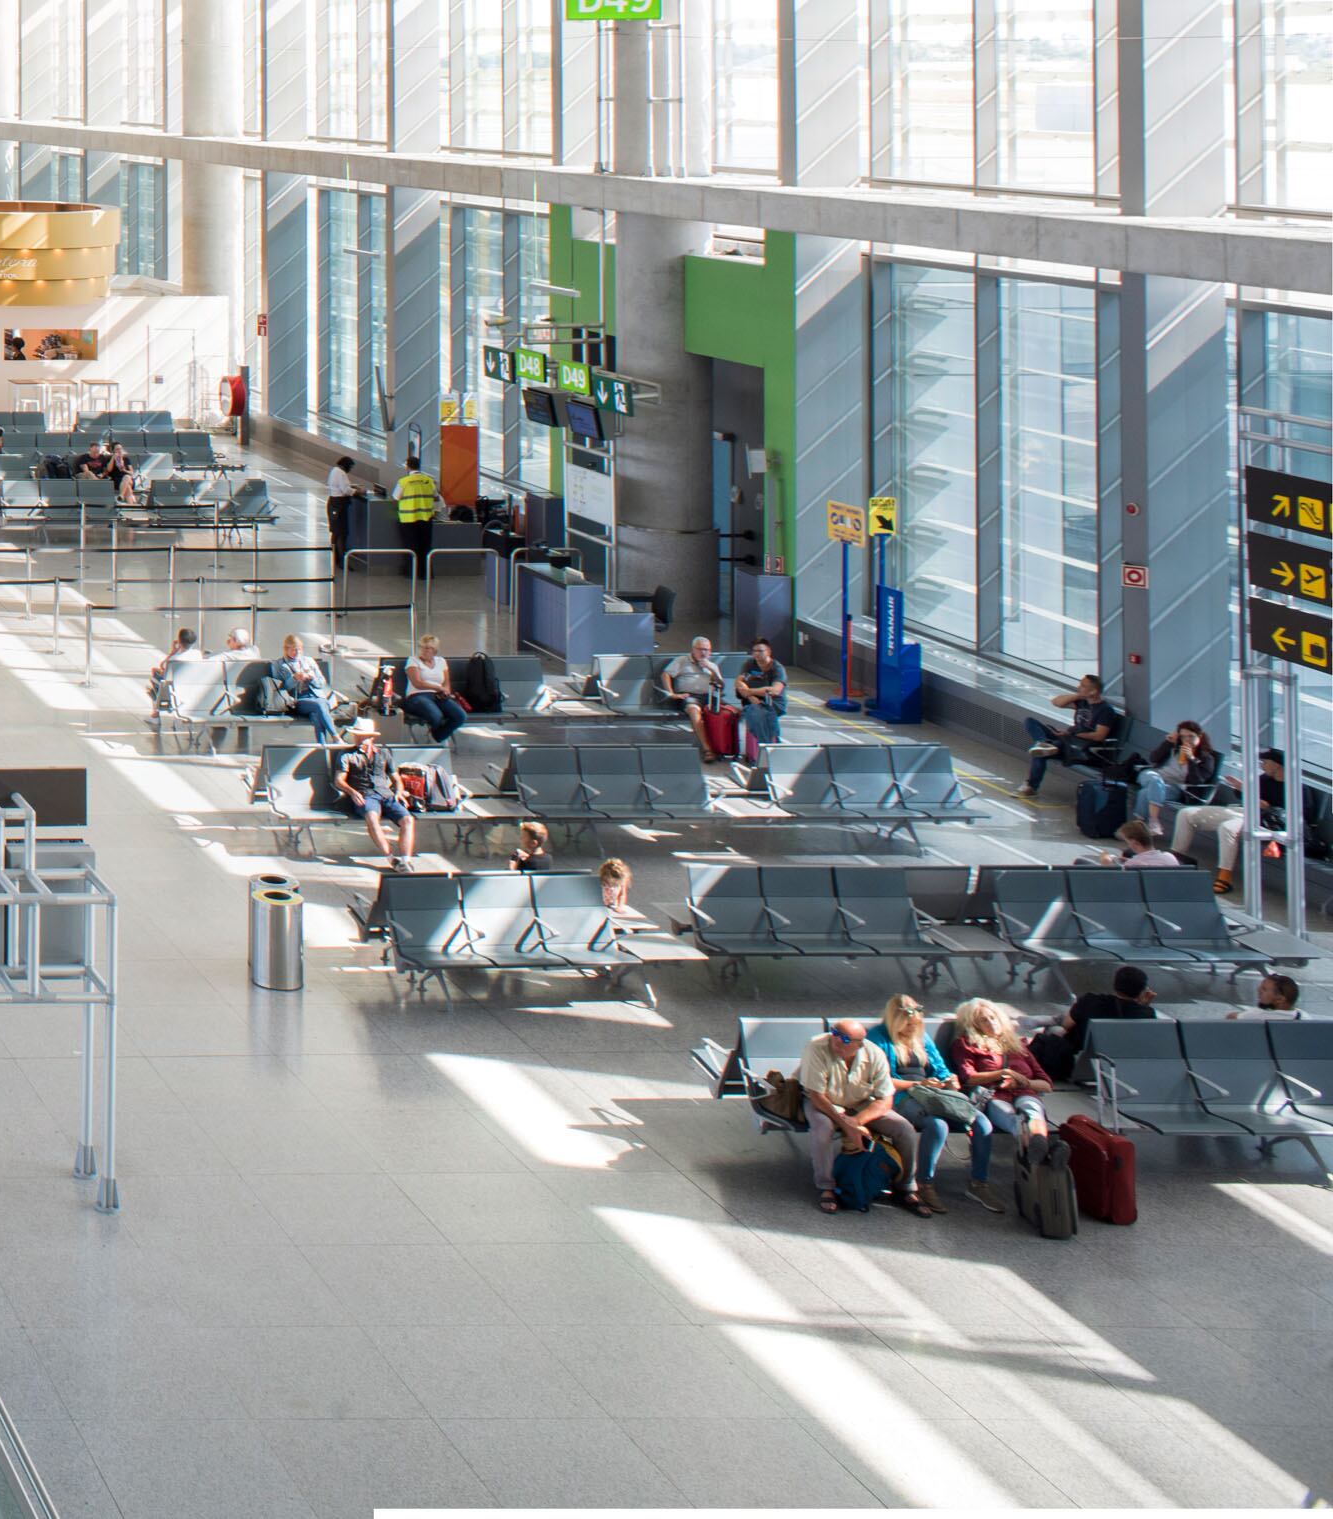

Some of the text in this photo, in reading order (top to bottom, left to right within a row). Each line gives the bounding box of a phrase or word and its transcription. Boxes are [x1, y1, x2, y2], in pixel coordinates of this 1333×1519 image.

[519, 353, 540, 377] D48
[562, 364, 586, 389] D49
[887, 595, 895, 650] RYANAIR
